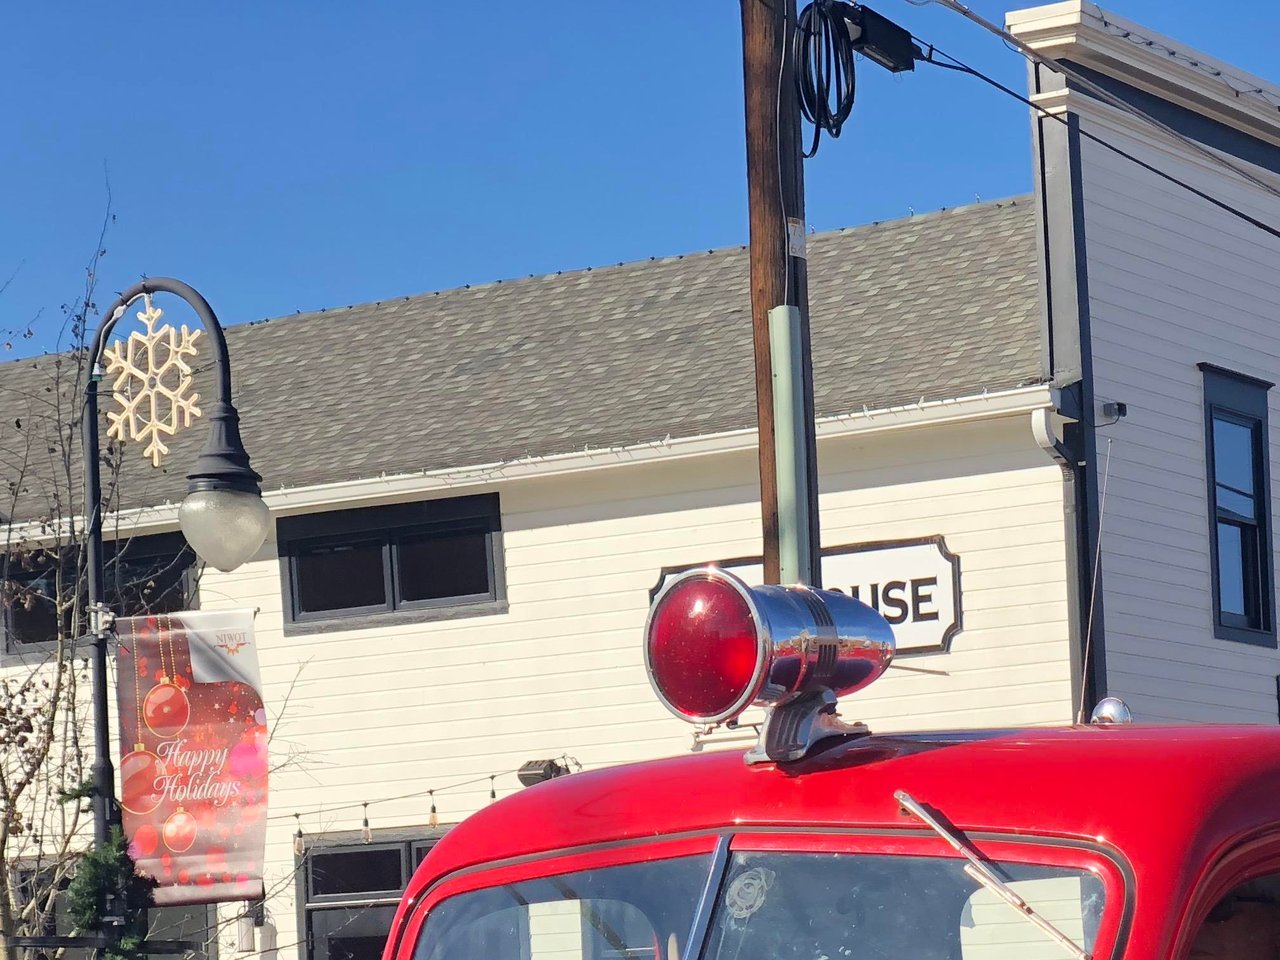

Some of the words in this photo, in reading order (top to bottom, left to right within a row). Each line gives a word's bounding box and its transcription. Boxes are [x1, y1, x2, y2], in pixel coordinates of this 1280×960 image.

[216, 632, 248, 645] NIWOT
[155, 738, 229, 775] Happy
[150, 769, 242, 807] Holidays
